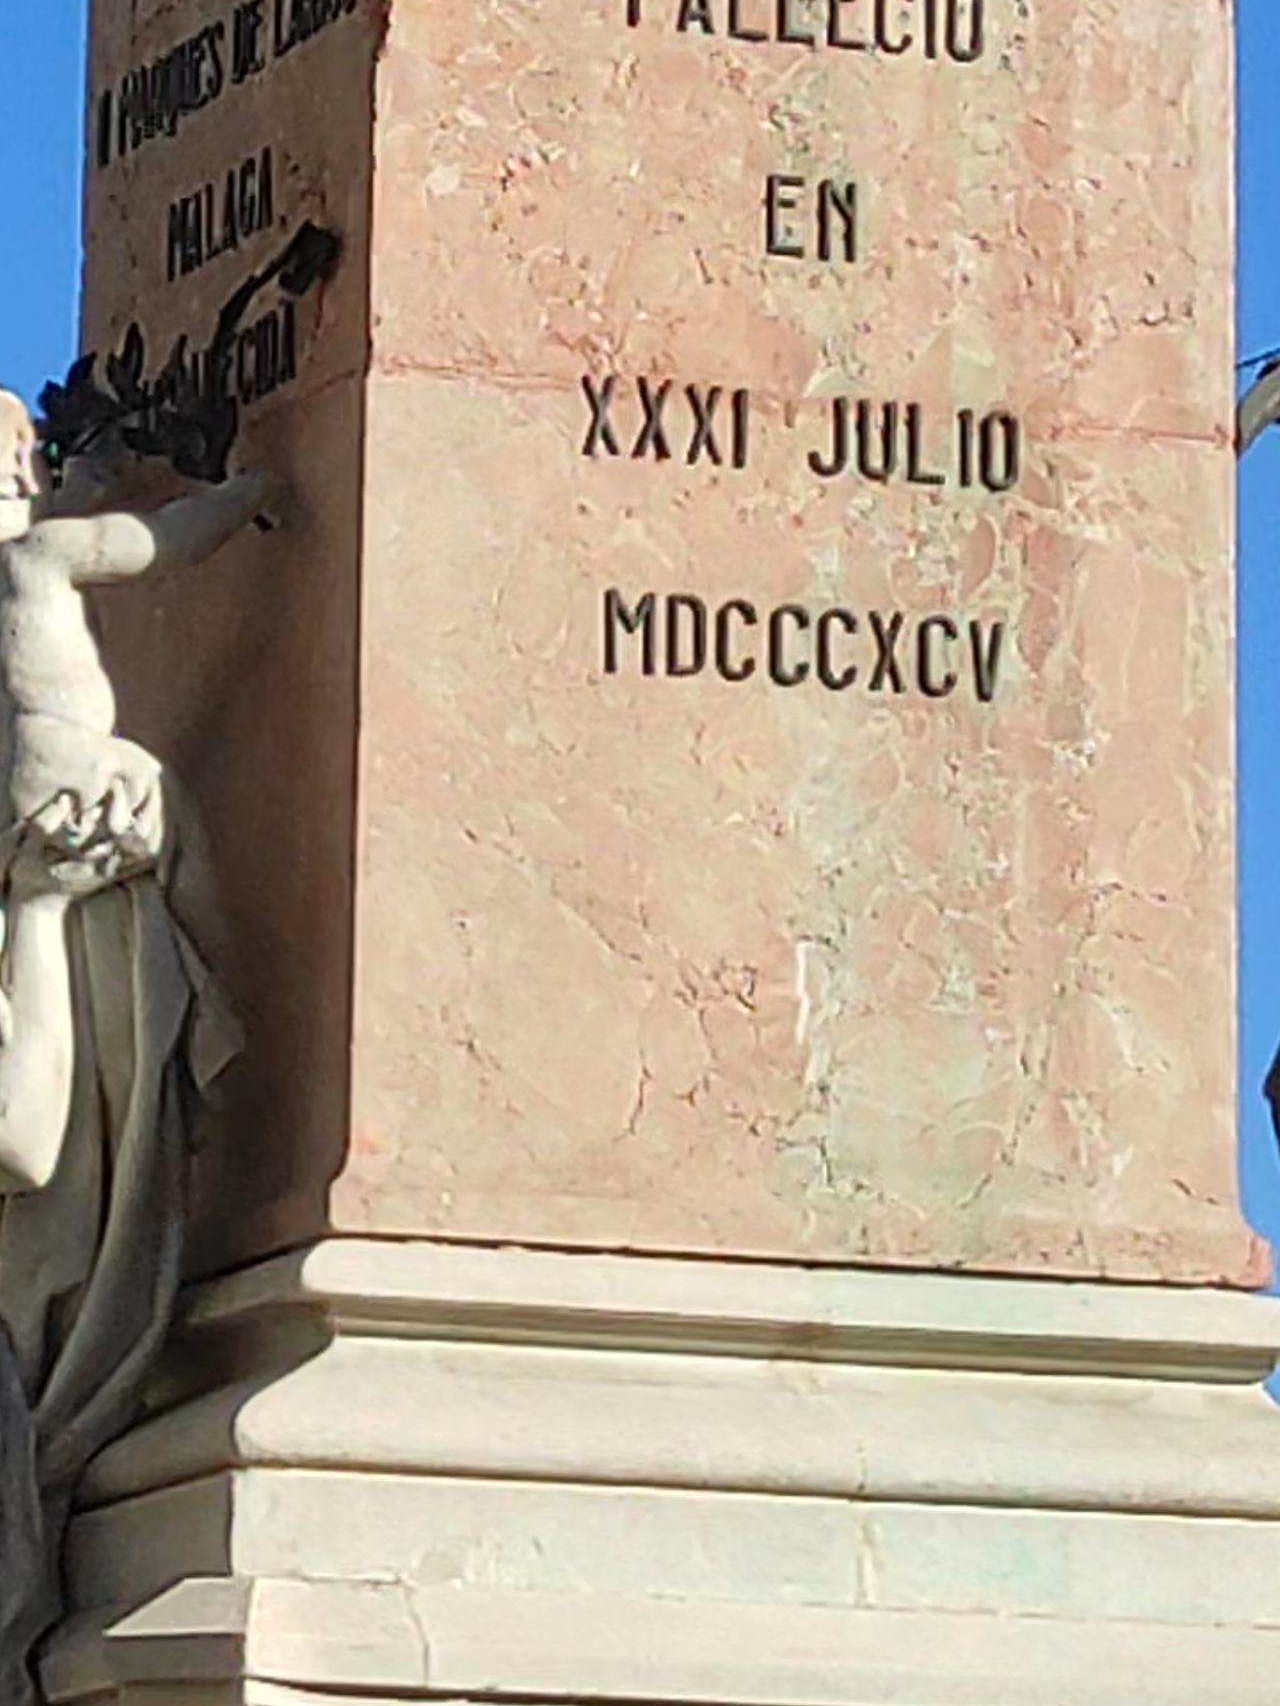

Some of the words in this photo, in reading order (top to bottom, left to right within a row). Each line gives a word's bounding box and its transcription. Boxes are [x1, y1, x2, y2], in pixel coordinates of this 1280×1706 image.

[119, 20, 225, 157] MARQUES
[166, 145, 272, 284] MALAGA
[764, 174, 857, 264] EN
[580, 374, 750, 470] XXXI
[807, 395, 1020, 493] JULIO
[602, 587, 1004, 704] MDCCCXCV
